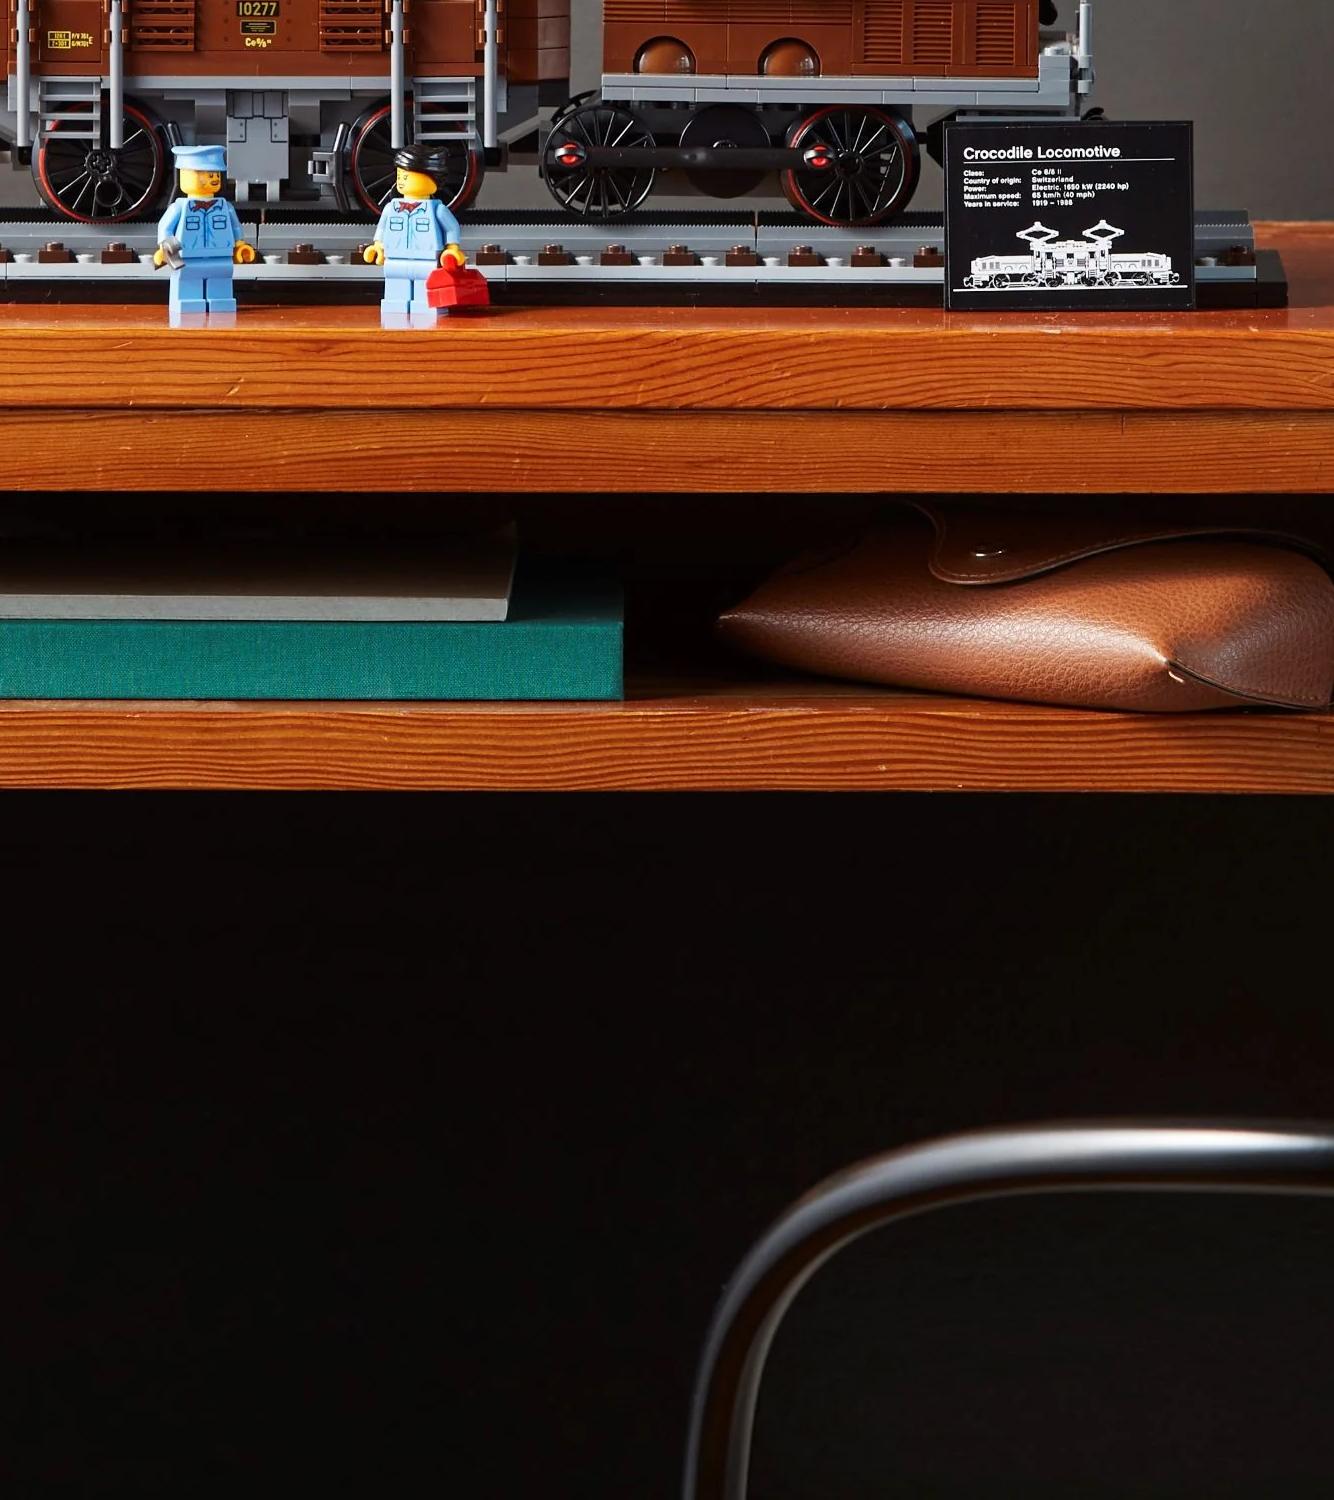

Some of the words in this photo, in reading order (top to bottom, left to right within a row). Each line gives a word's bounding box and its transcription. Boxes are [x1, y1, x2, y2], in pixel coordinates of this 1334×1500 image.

[239, 2, 277, 16] 10277
[963, 146, 1033, 160] Crocodile
[1037, 145, 1121, 159] Locomotive
[963, 169, 985, 177] Class:
[963, 177, 991, 186] Country
[1000, 177, 1022, 185] origin:
[1064, 183, 1080, 191] 1650
[1117, 182, 1129, 191] hp)
[998, 192, 1022, 201] speed:
[1063, 191, 1074, 199] (40
[1076, 190, 1095, 200] mph)
[963, 200, 983, 208] Years
[1032, 199, 1048, 207] 1919
